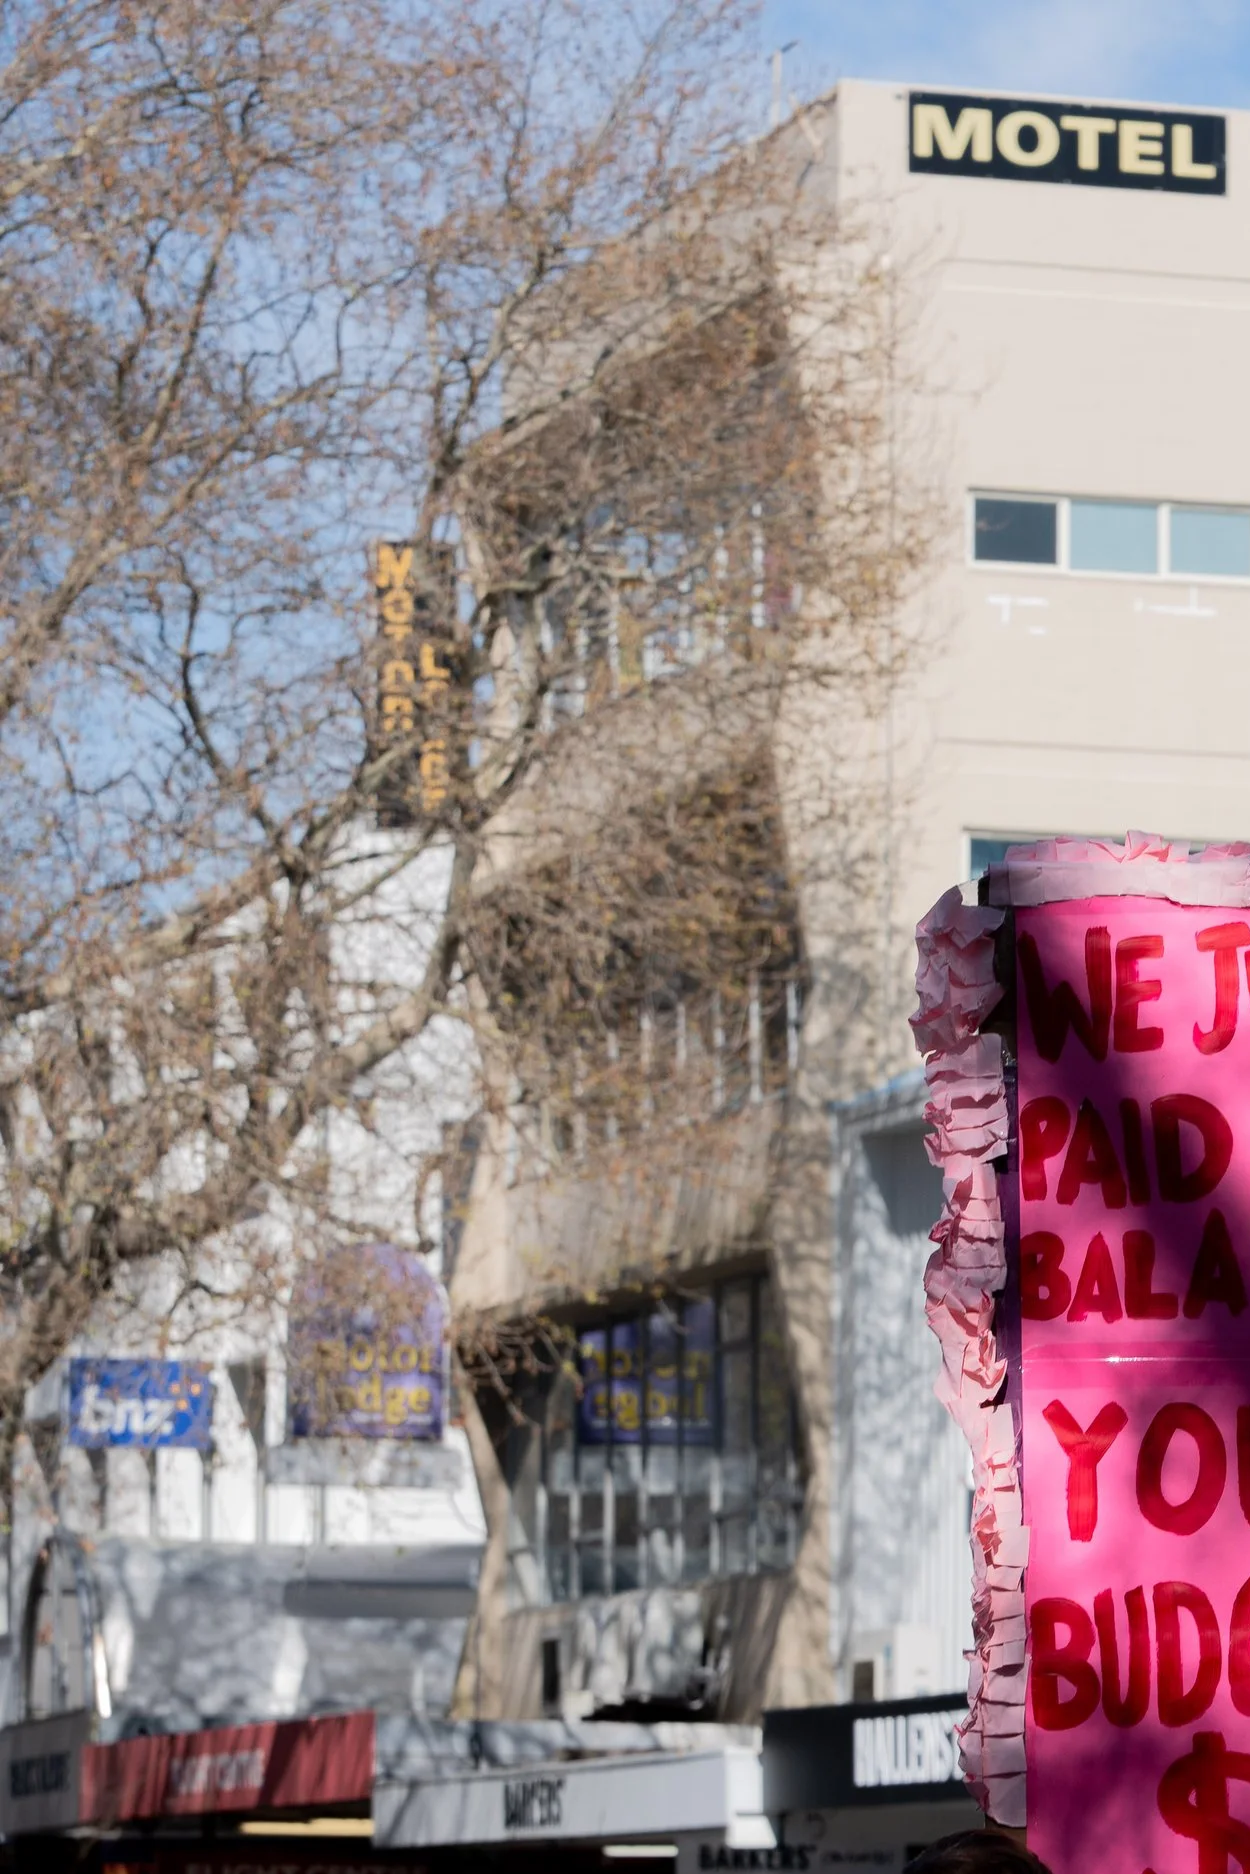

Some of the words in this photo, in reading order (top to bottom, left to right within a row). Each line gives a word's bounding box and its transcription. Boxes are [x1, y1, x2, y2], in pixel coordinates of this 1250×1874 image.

[912, 103, 1217, 180] MOTEL
[1017, 925, 1164, 1064] WE
[1019, 1093, 1234, 1209] PAID
